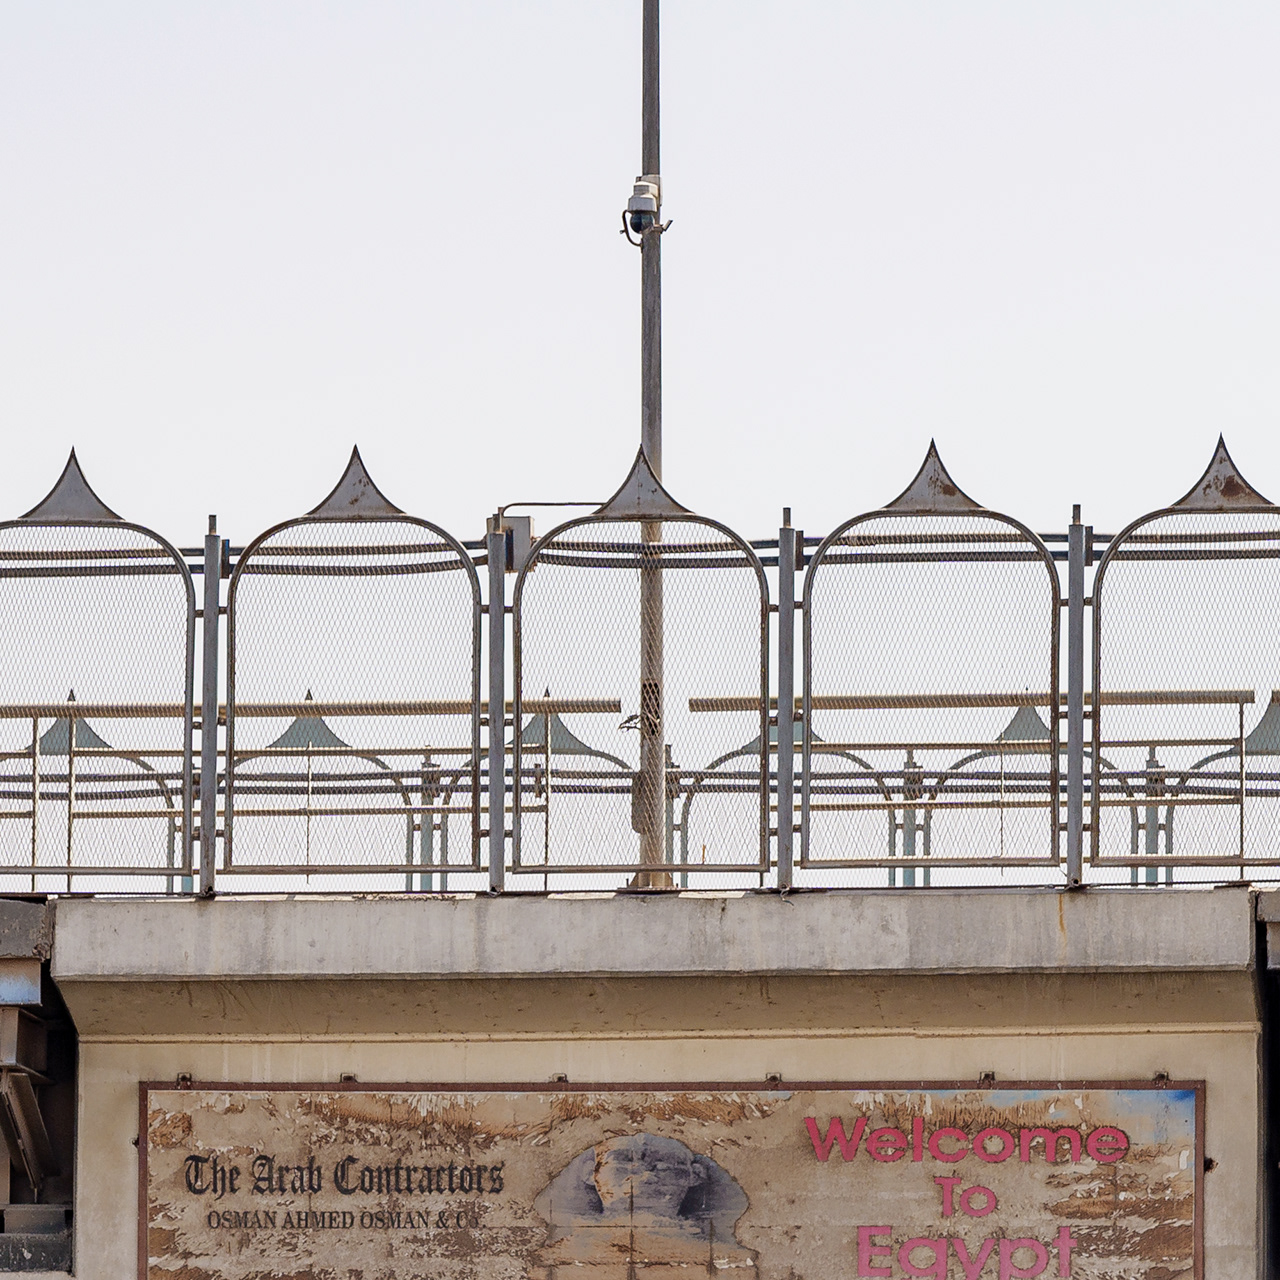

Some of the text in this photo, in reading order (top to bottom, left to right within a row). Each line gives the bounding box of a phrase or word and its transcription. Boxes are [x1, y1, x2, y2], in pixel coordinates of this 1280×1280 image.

[804, 1116, 1129, 1163] Welcome
[184, 1153, 505, 1201] The Arab Contractors
[934, 1176, 998, 1219] To
[207, 1210, 276, 1230] OSMAN
[282, 1210, 355, 1230] AHMED
[359, 1210, 429, 1230] OSMAN
[435, 1210, 450, 1229] &
